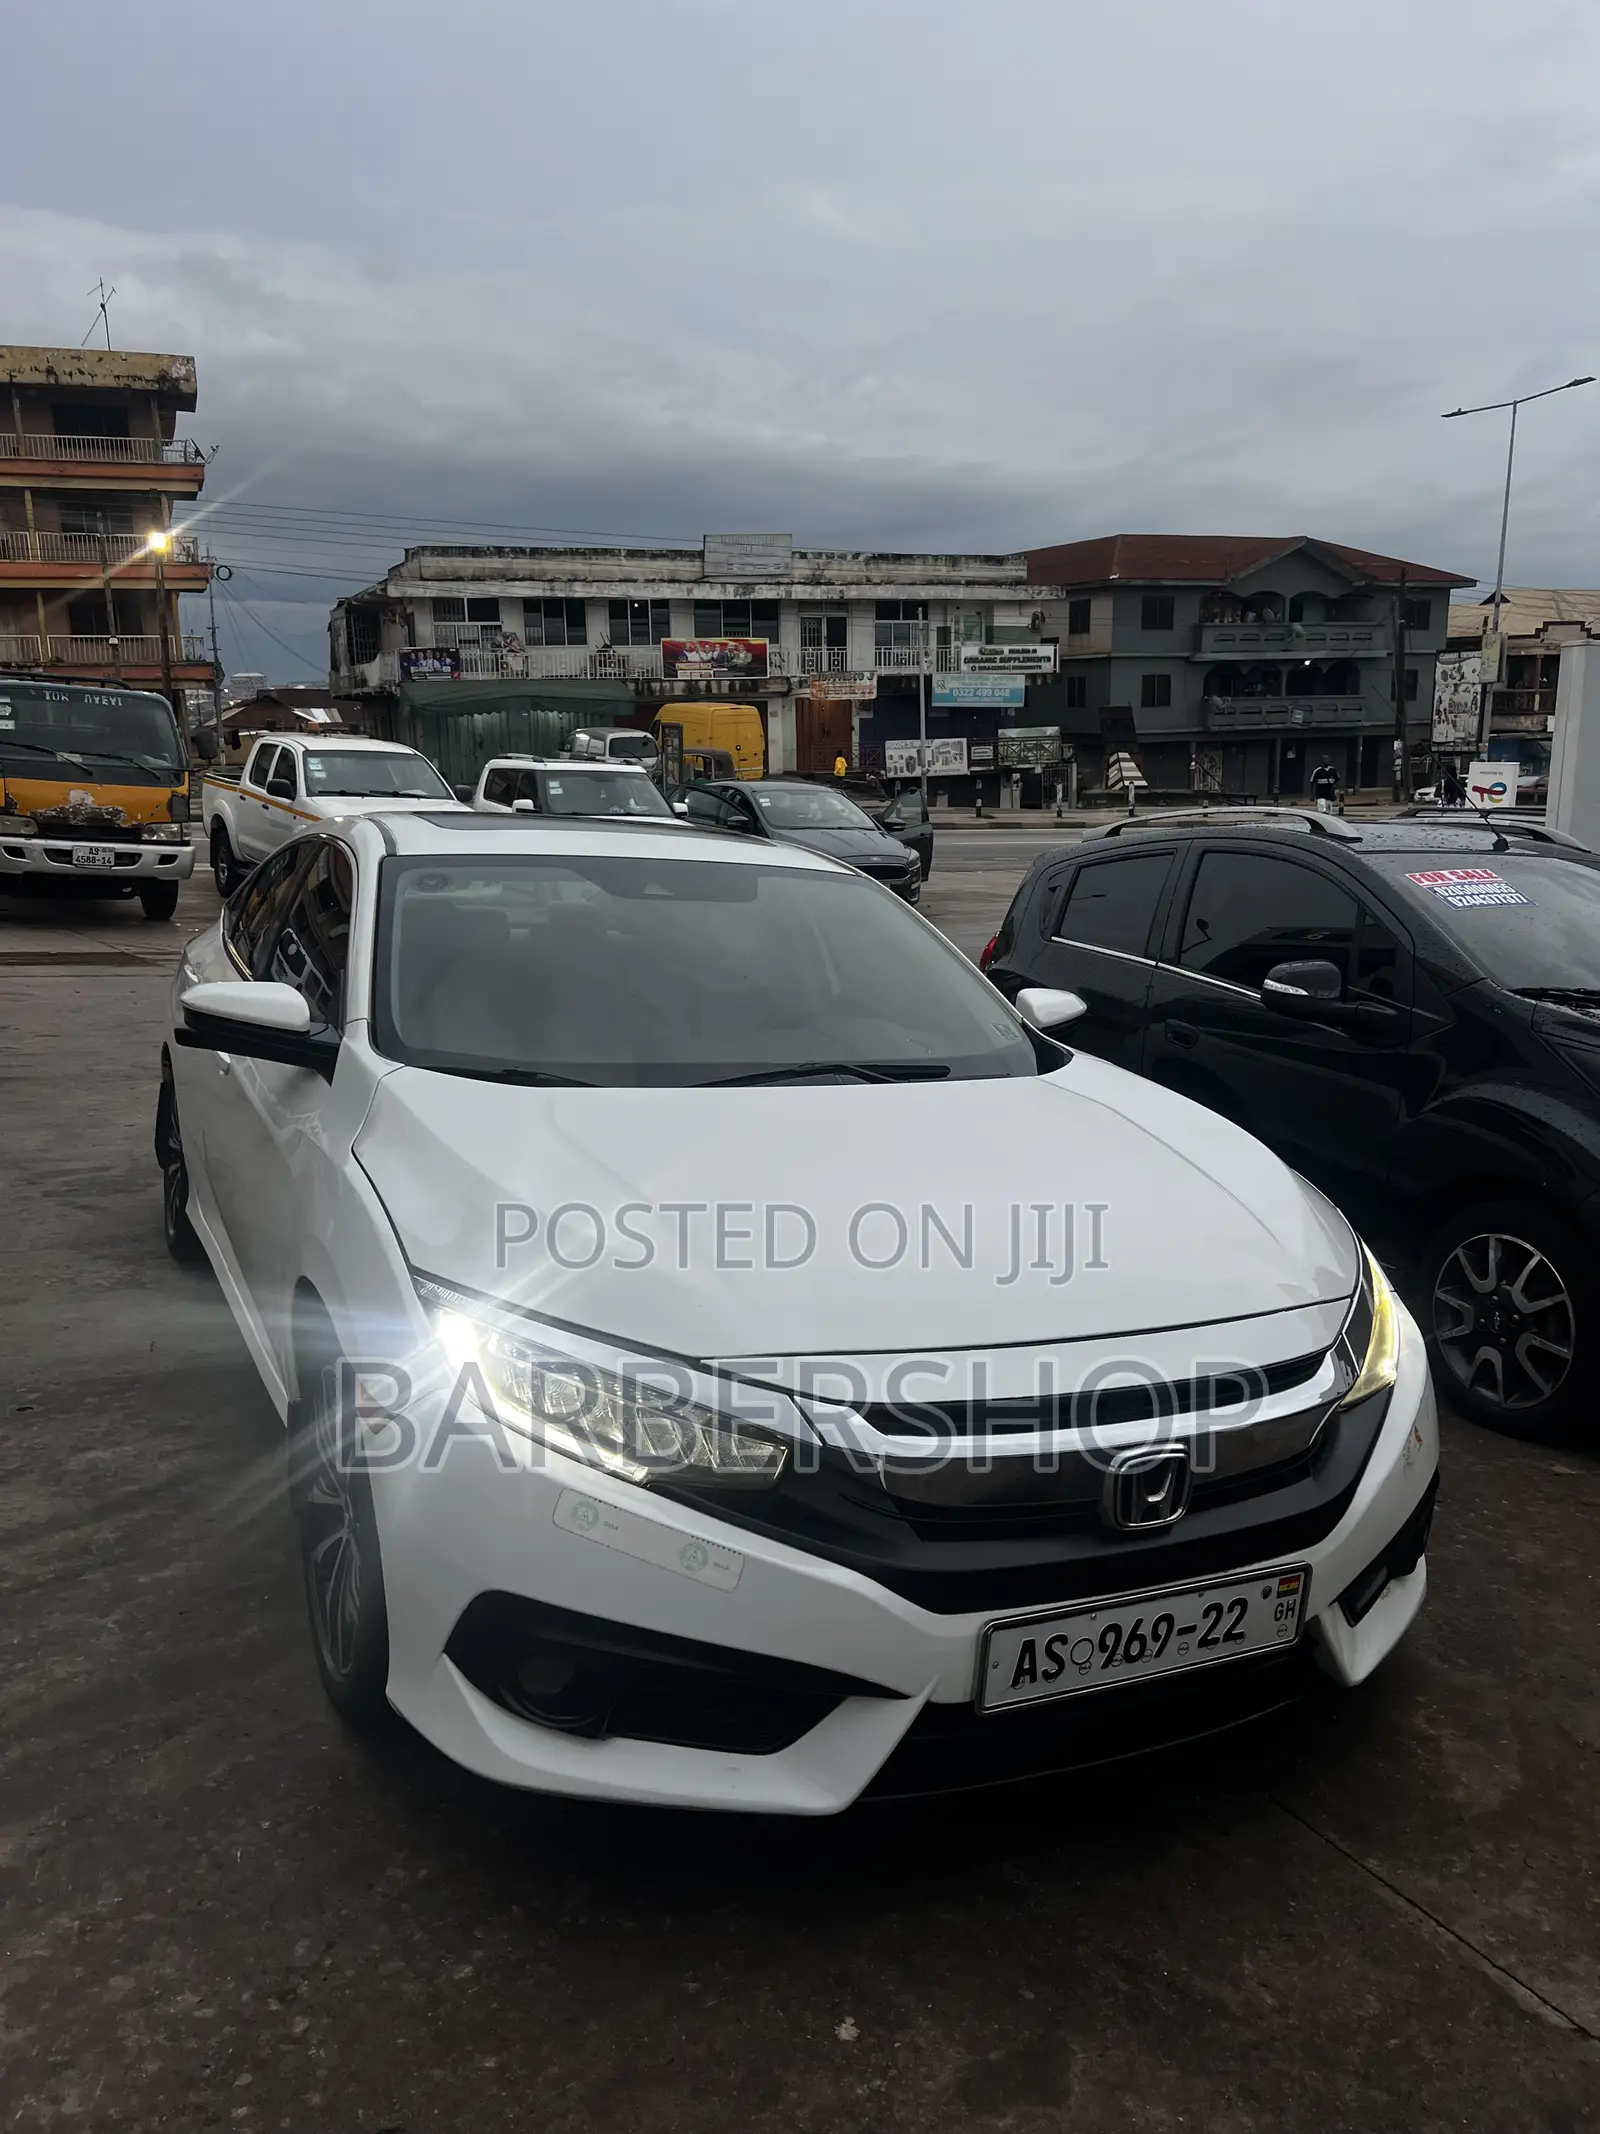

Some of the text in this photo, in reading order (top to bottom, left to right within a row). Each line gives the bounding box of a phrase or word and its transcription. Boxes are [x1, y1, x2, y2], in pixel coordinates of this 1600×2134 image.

[963, 655, 1051, 664] ORGANIC SUPPLEMENTS
[952, 688, 974, 697] 0322
[975, 688, 993, 697] 499
[88, 847, 101, 856] AS
[75, 855, 113, 865] 4588-14
[1408, 870, 1499, 884] FOR SALE
[1446, 893, 1529, 907] 0244377377
[1273, 1600, 1296, 1622] GH
[1011, 1597, 1249, 1687] AS 969-22
